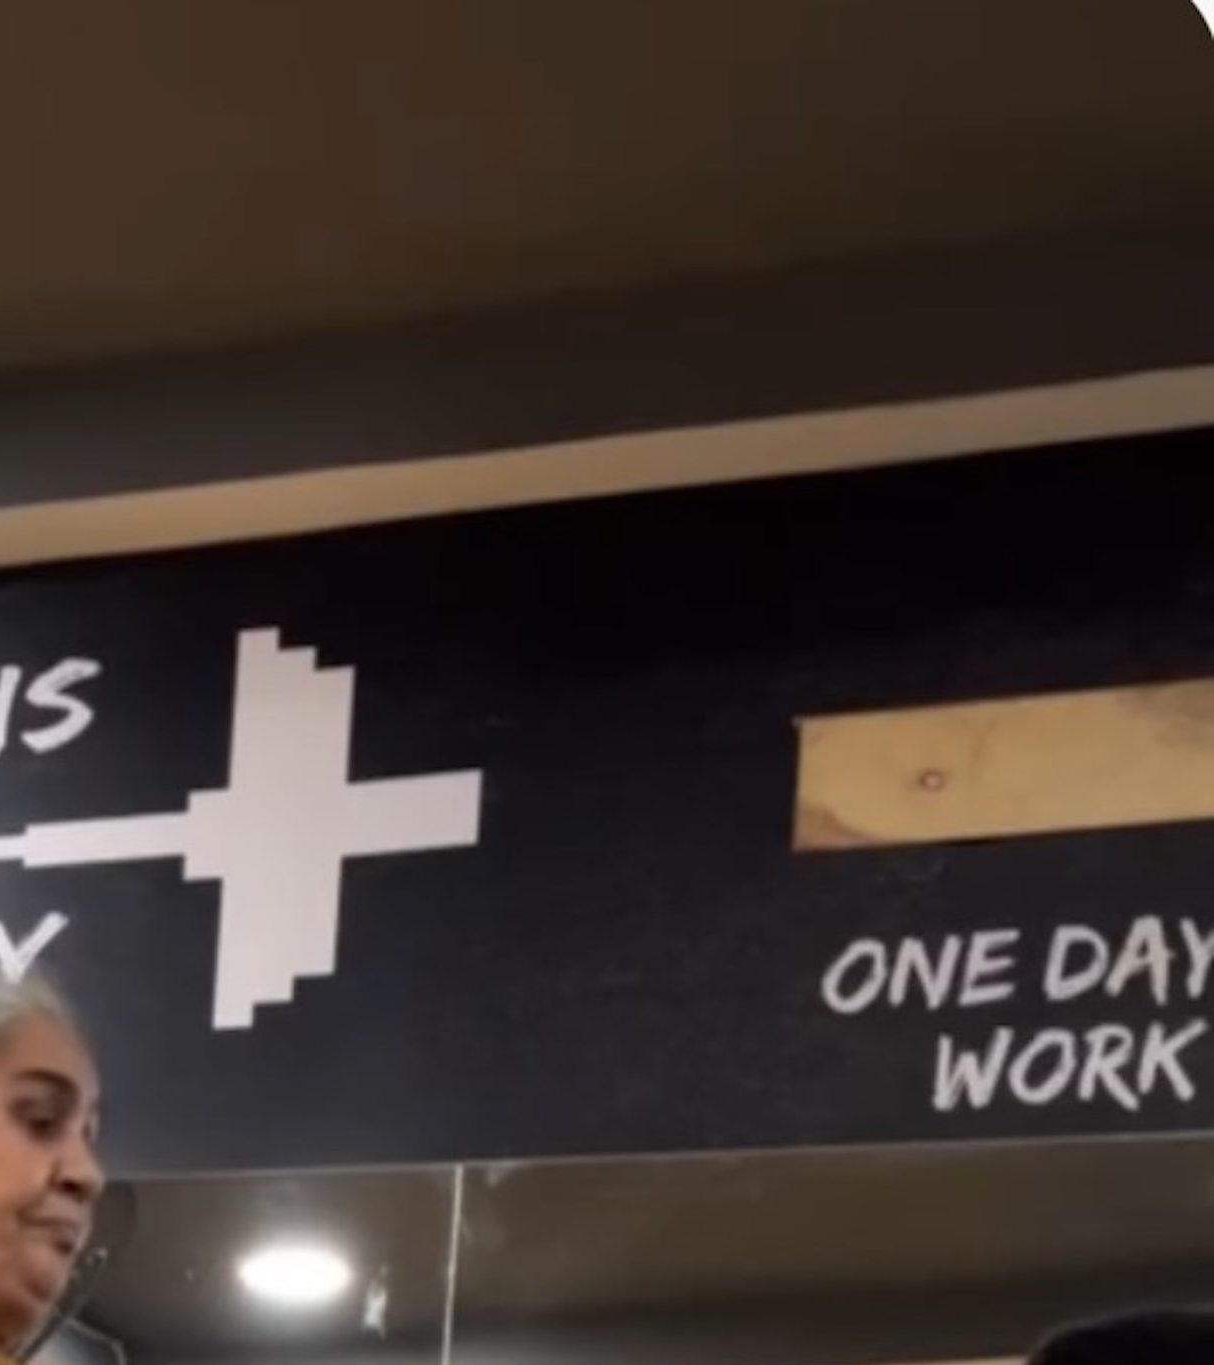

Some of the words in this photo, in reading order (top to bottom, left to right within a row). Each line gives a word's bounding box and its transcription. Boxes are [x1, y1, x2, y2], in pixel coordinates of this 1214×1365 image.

[820, 928, 1022, 1014] ONE
[1042, 914, 1214, 1006] DAY
[932, 1016, 1210, 1112] WORK
